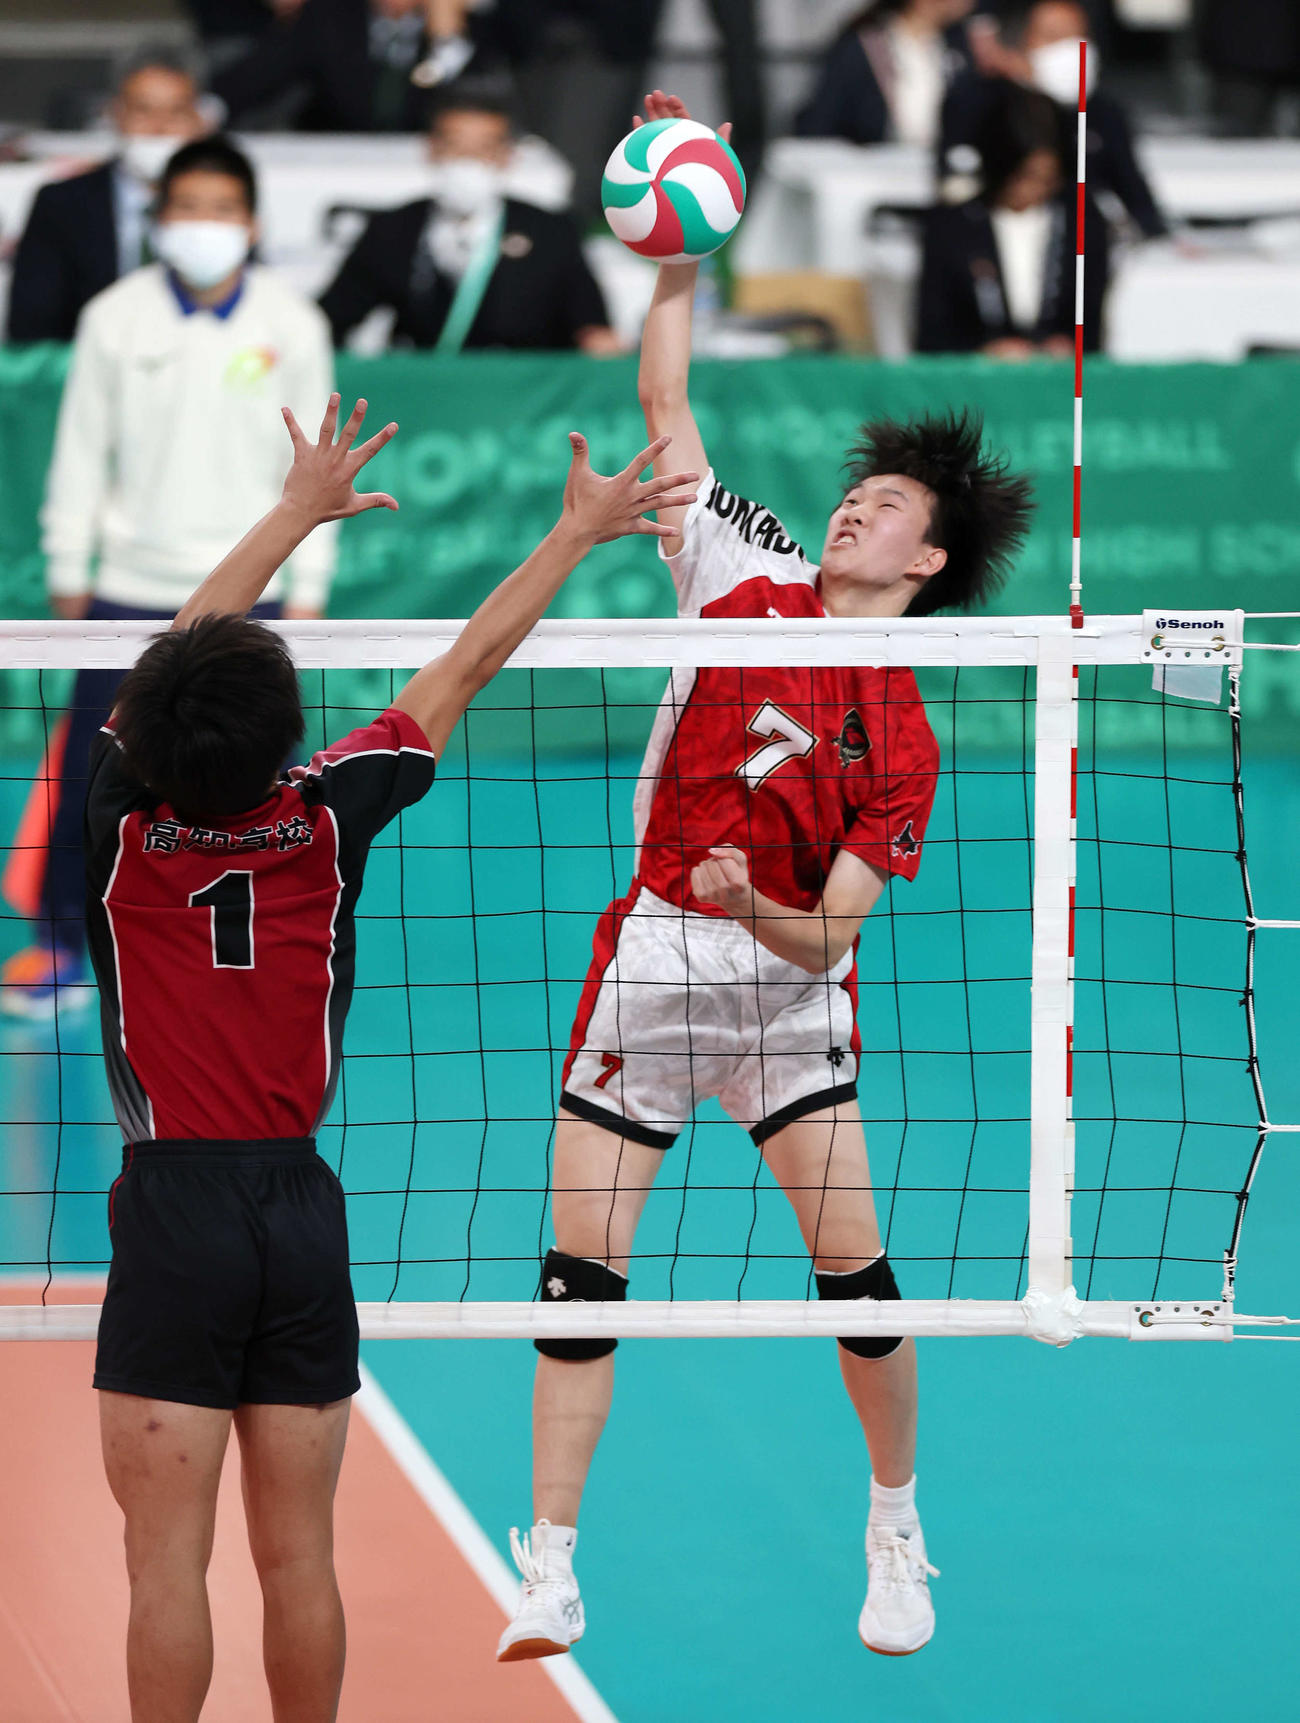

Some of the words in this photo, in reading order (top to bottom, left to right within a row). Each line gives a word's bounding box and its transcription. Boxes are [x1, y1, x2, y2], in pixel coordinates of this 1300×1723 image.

[1167, 619, 1224, 629] Senoh
[734, 697, 820, 793] 7
[187, 869, 255, 969] 1
[593, 1052, 625, 1089] 7
